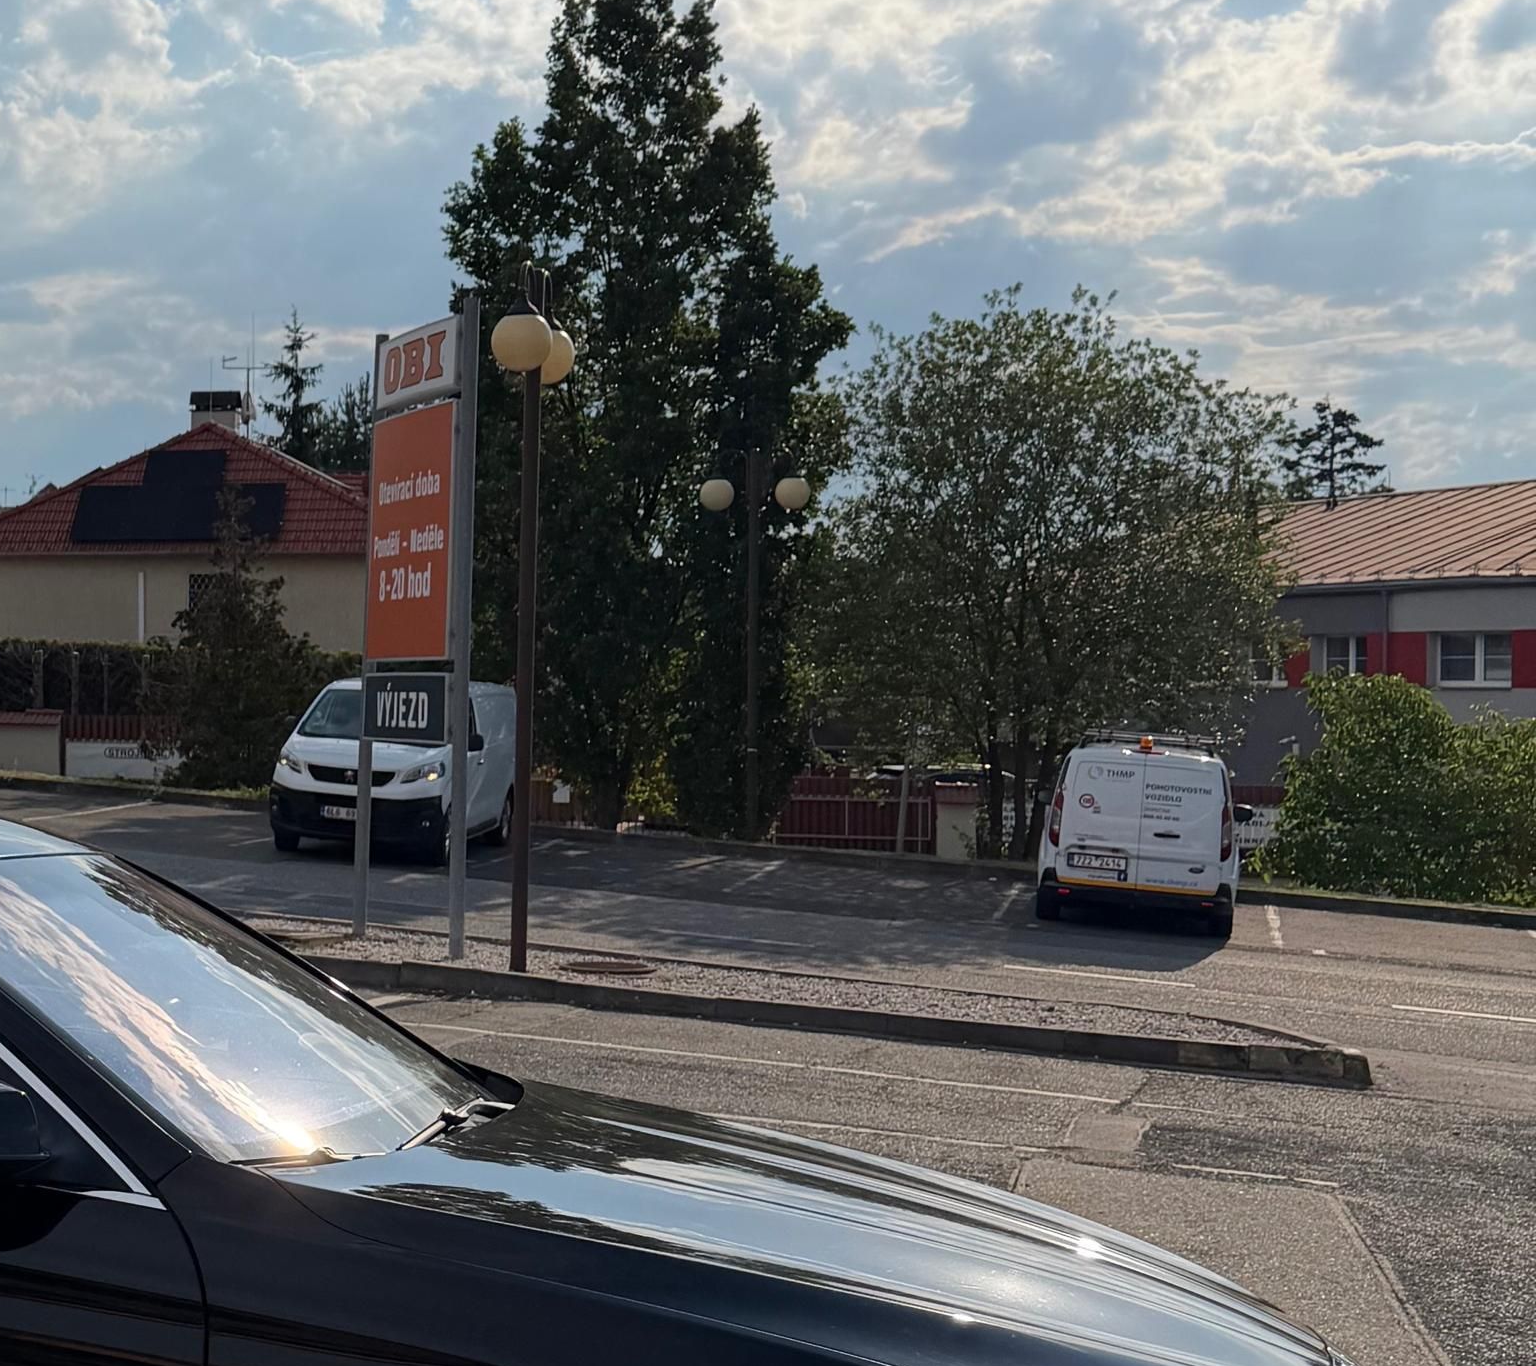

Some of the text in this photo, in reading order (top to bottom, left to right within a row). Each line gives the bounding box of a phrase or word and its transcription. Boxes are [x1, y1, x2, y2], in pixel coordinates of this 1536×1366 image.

[384, 330, 447, 395] OBI
[378, 469, 440, 506] Otevírací doba
[373, 530, 400, 560] Pondělí
[410, 523, 444, 553] Neděle
[378, 561, 432, 602] 8-20 hod
[376, 682, 429, 730] VÝJEZD
[1106, 768, 1136, 779] THMP
[1144, 793, 1182, 803] VOZIDLO
